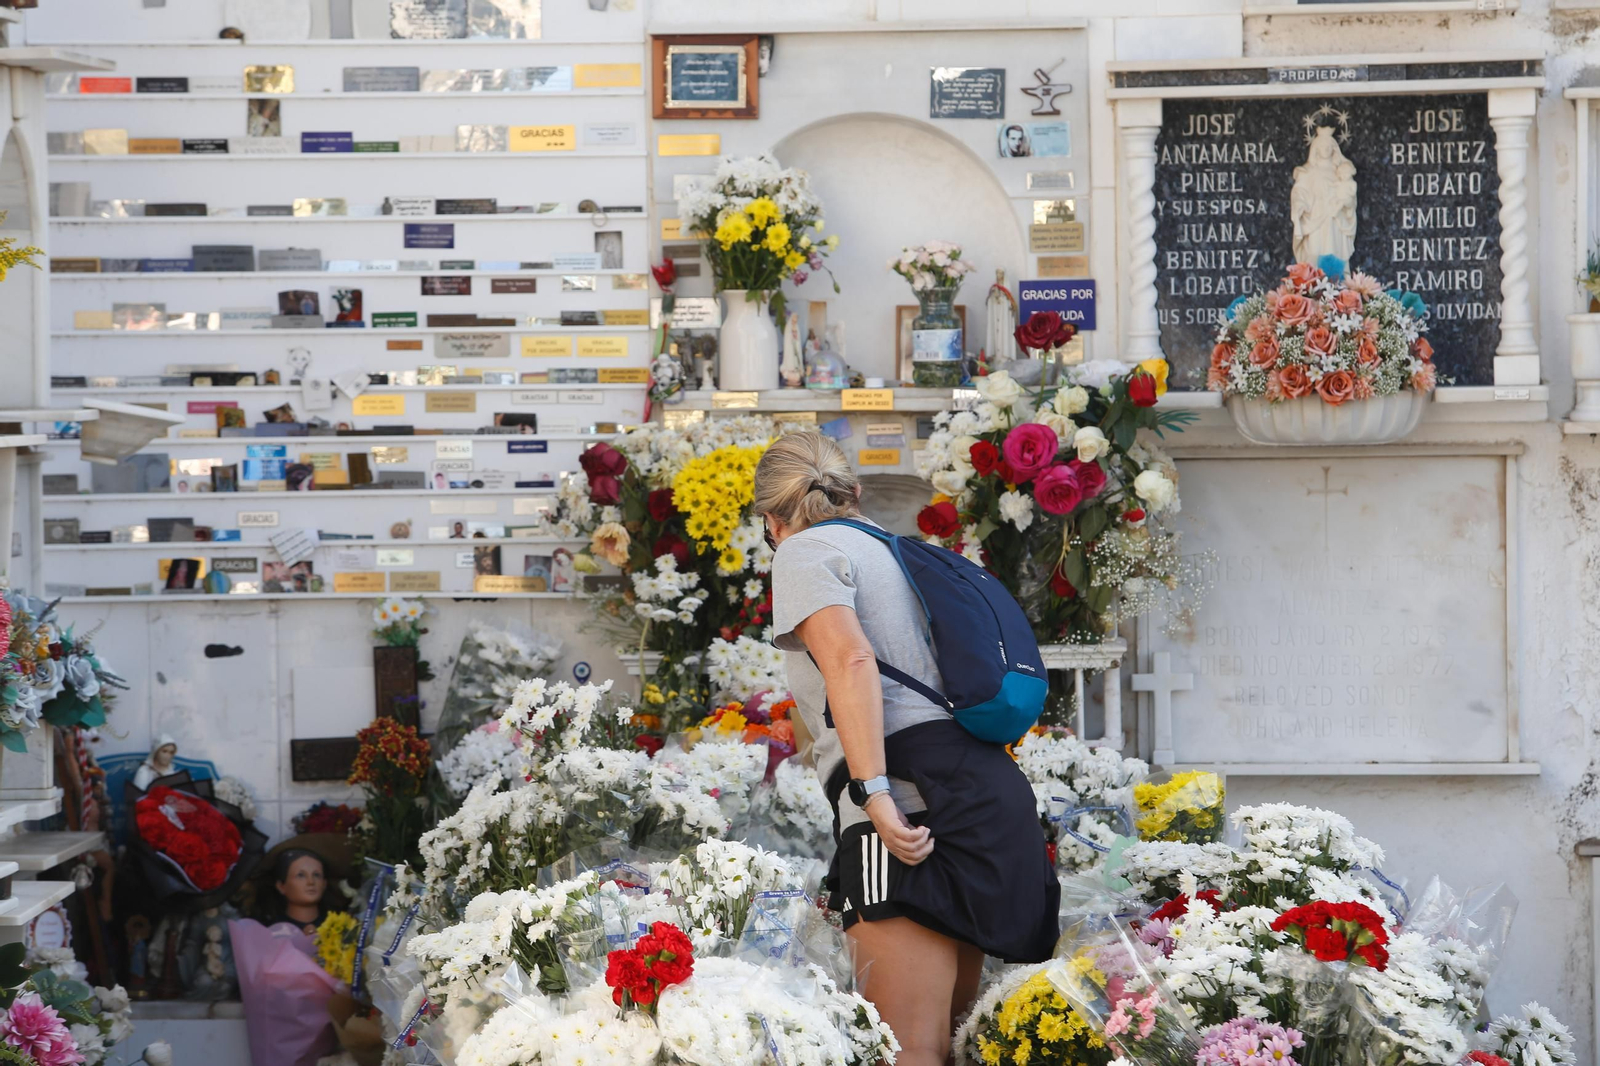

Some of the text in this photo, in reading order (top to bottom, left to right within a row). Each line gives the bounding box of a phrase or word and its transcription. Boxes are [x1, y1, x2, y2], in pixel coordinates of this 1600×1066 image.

[1182, 113, 1236, 136] JOSE
[1409, 109, 1464, 133] JOSE
[520, 128, 564, 138] GRACIAS
[1155, 142, 1278, 165] ANTAMARIA
[1391, 141, 1486, 165] BENITEZ
[1180, 169, 1244, 193] PIÑEL
[1396, 171, 1481, 196] LOBATO
[1157, 199, 1267, 216] Y SU ESPOSA
[1401, 205, 1476, 229] EMILIO
[1176, 222, 1249, 244] JUANA
[1166, 249, 1259, 270] BENITEZ
[1392, 236, 1487, 262] BENITEZ
[1170, 275, 1253, 296] LOBATO
[1396, 268, 1483, 291] RAMIRO
[1022, 288, 1093, 300] GRACIAS POR
[1056, 310, 1085, 320] YUDA
[1158, 308, 1180, 324] US
[436, 462, 470, 470] GRACIAS
[242, 514, 275, 524] GRACIAS
[214, 560, 254, 570] GRACIAS
[1204, 625, 1259, 647] BORN
[1270, 625, 1368, 647] JANUARY
[1380, 625, 1391, 646] 2
[1198, 655, 1243, 677] DIED
[1253, 654, 1363, 677] NOVEMBER
[1403, 654, 1455, 677] 1977
[1235, 685, 1421, 707] BELOVED SON OF
[1228, 716, 1430, 738] JOHN AND HELENA
